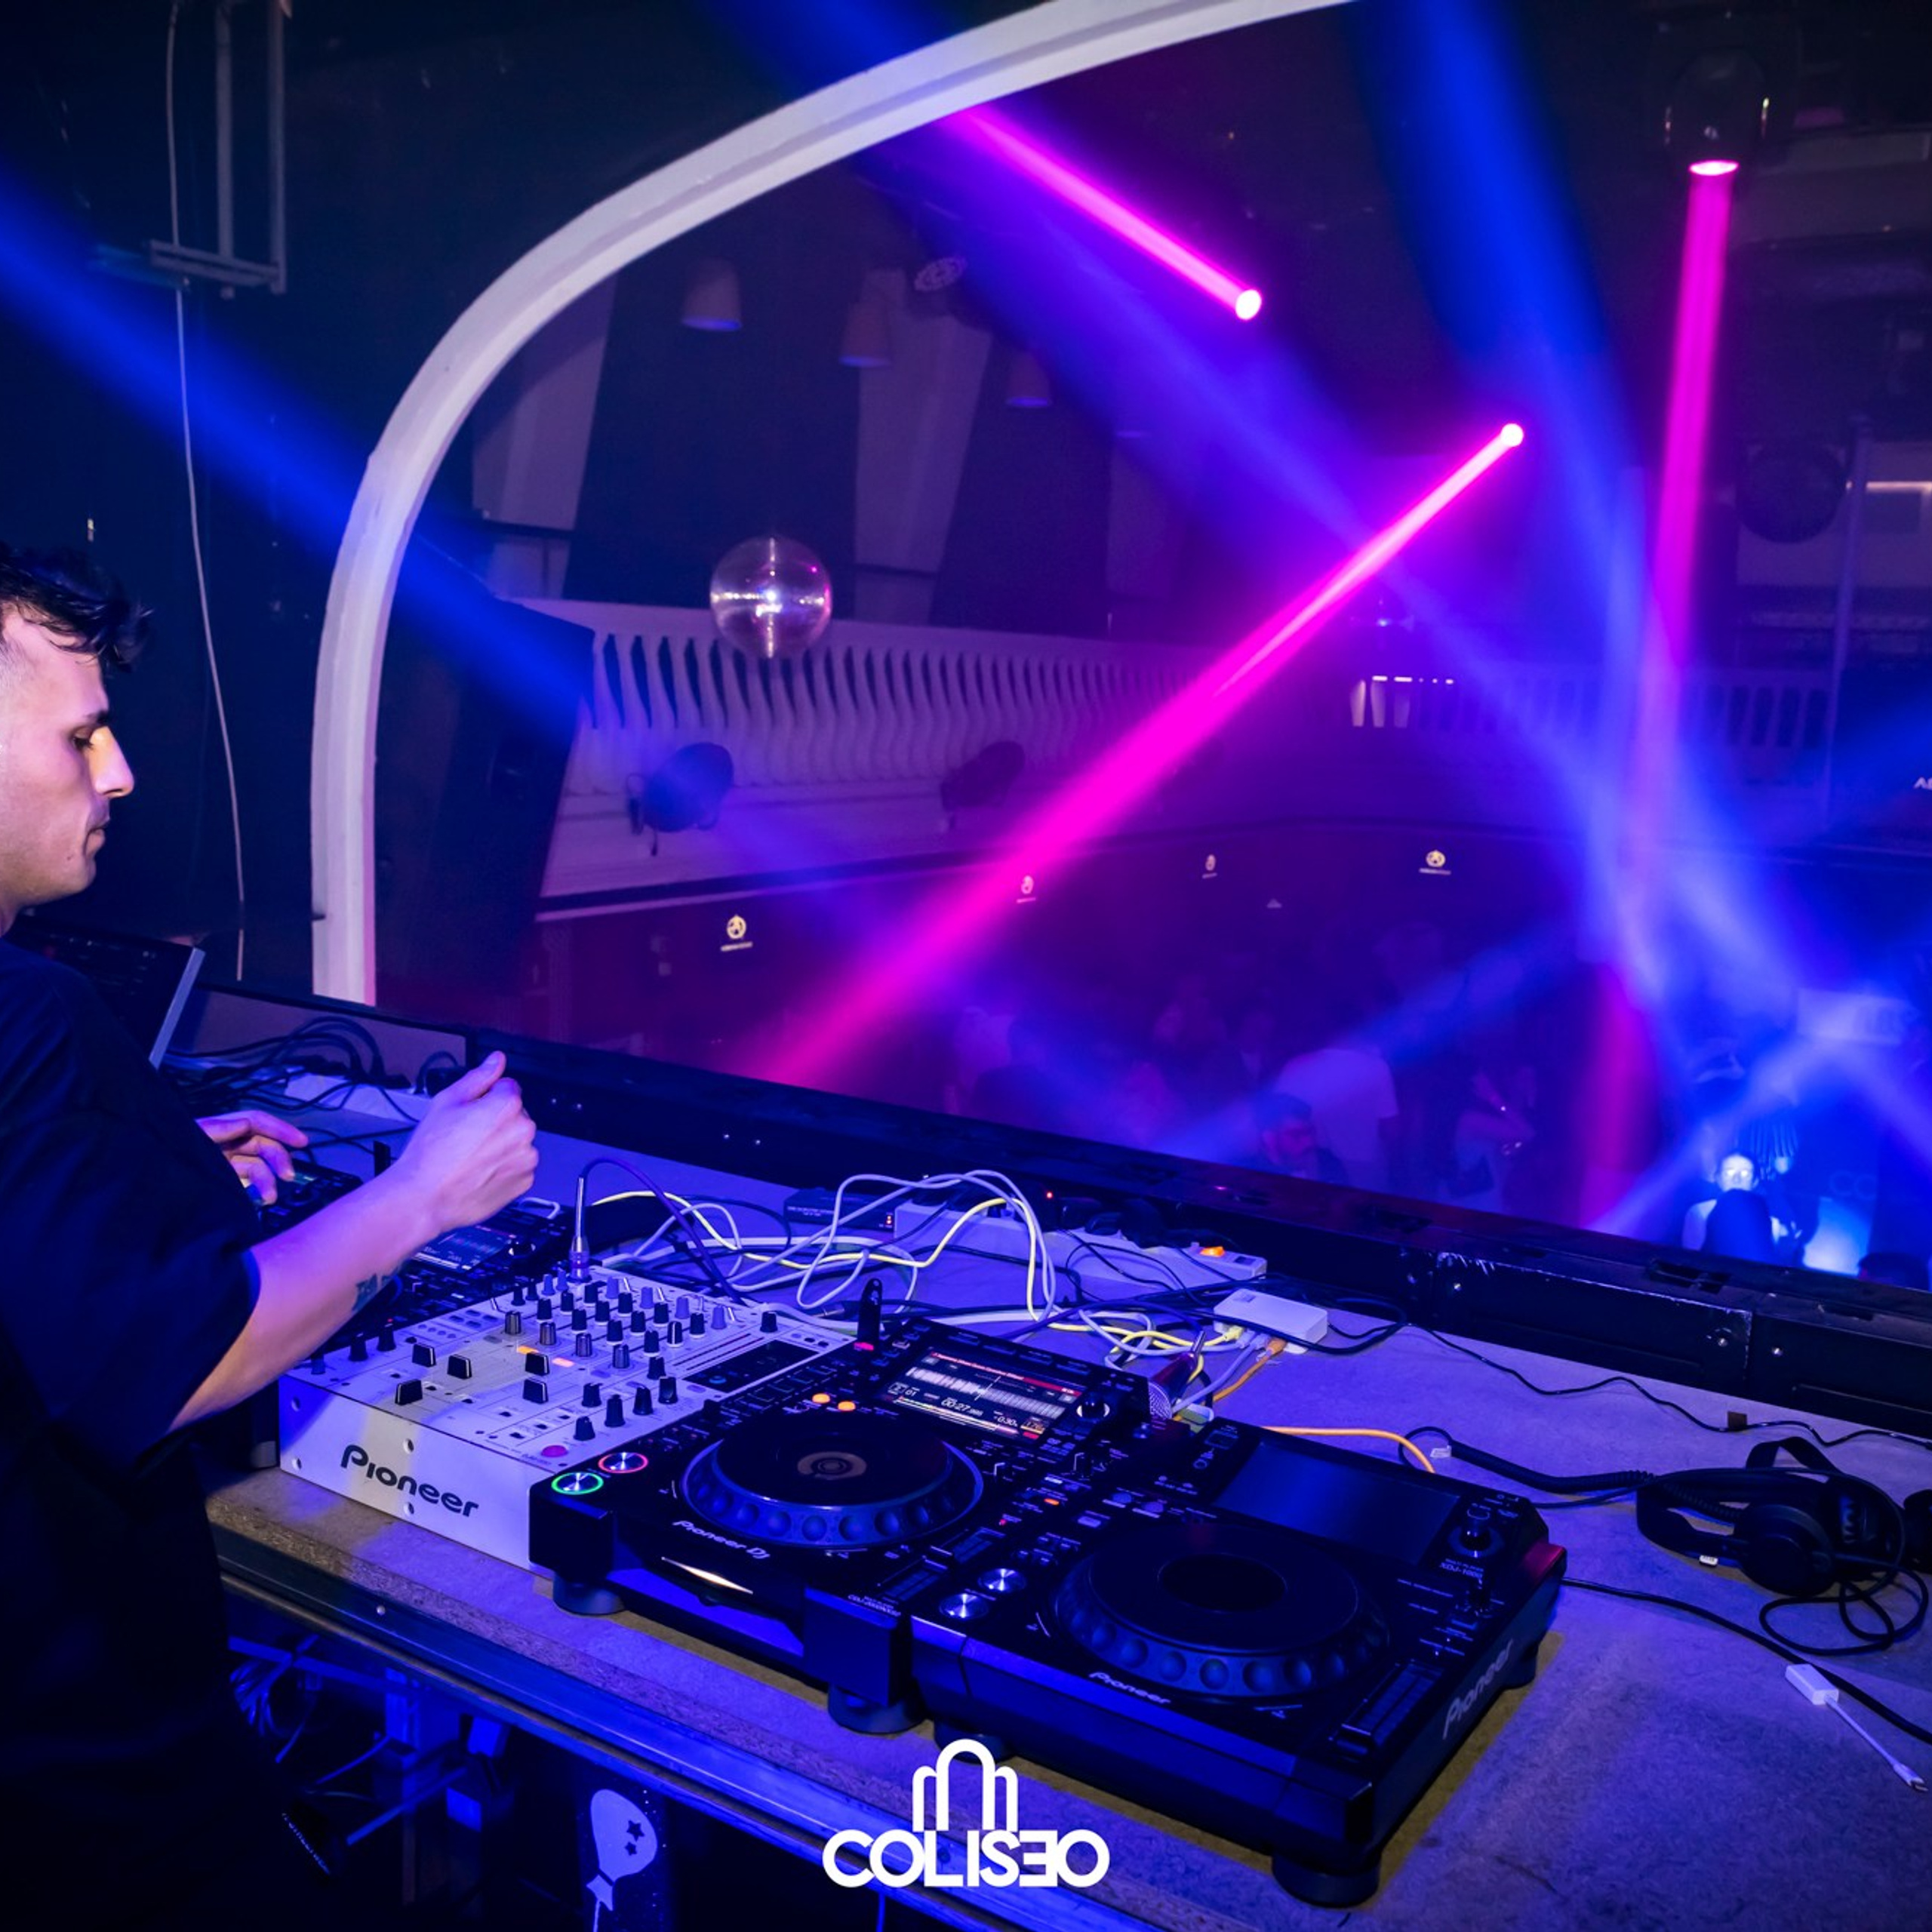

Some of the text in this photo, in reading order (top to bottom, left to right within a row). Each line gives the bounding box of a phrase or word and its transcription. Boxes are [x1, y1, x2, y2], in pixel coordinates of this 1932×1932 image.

[341, 1444, 479, 1517] Pioneer
[672, 1520, 771, 1559] Pioneer DJ
[1088, 1671, 1172, 1704] Pioneer
[1442, 1638, 1514, 1740] Pioneer
